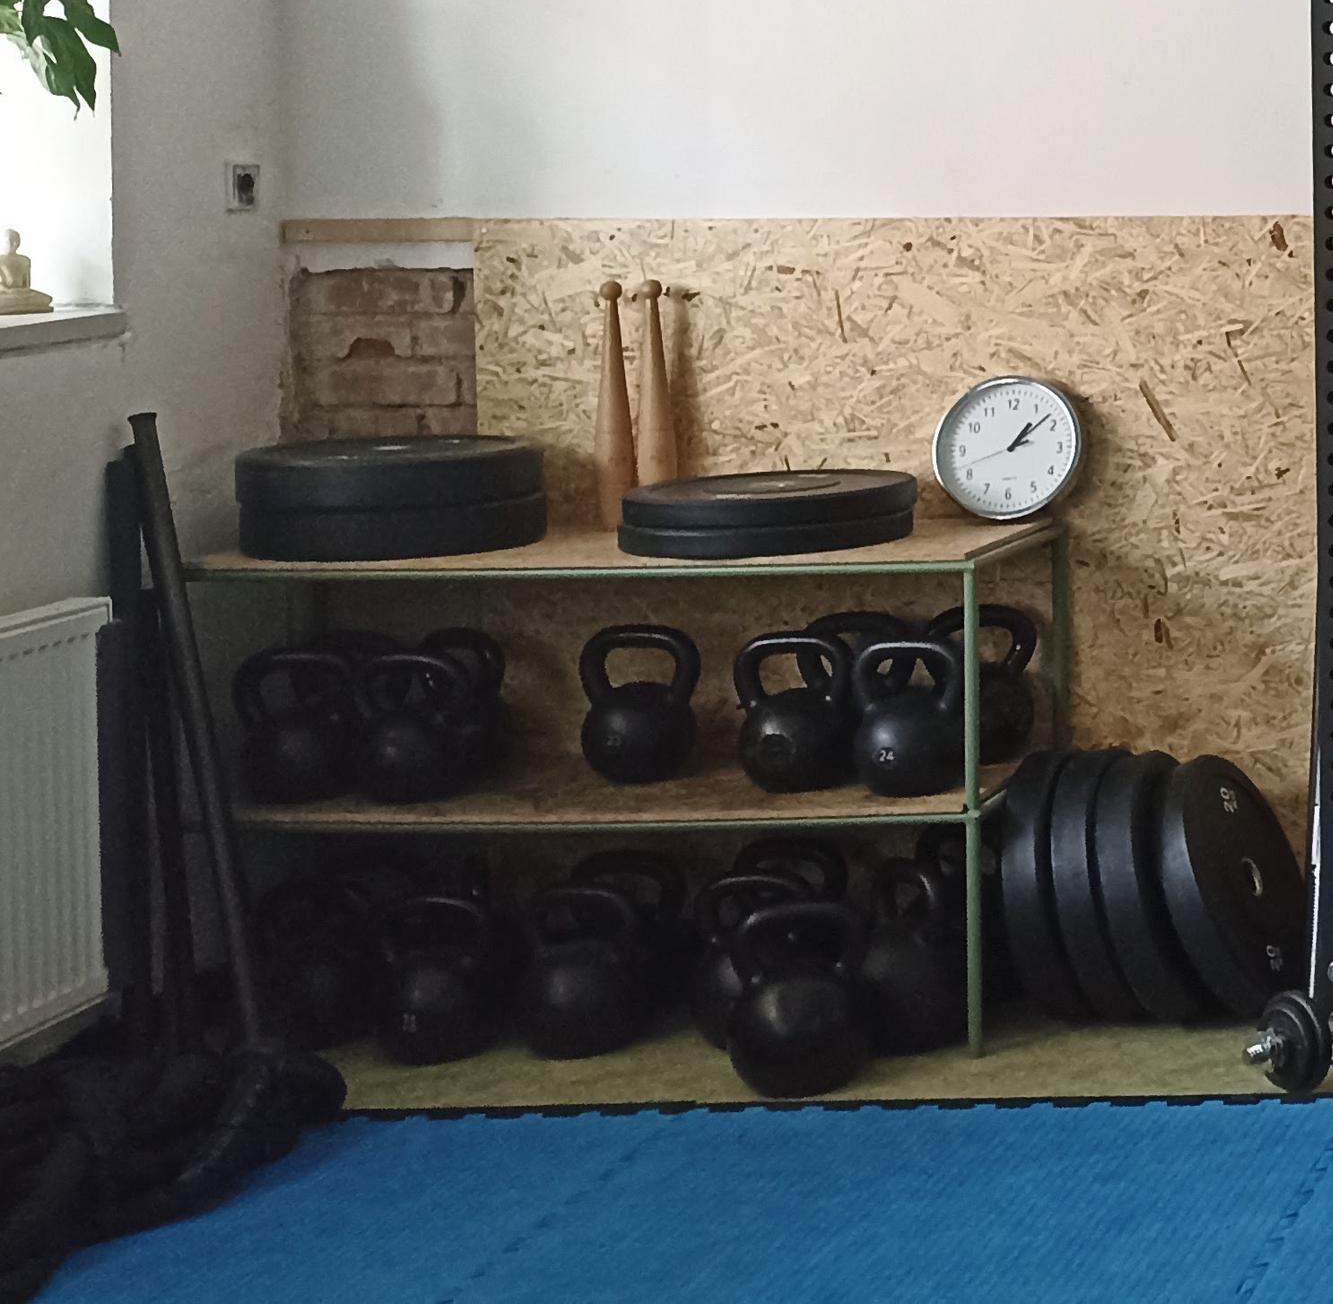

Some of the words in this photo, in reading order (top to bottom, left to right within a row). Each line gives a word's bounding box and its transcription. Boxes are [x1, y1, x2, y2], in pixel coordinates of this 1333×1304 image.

[1007, 398, 1020, 411] 12
[983, 407, 996, 418] 11
[968, 421, 981, 434] 10
[1049, 419, 1057, 432] 2
[958, 445, 966, 457] 9
[1056, 442, 1063, 454] 3
[966, 469, 973, 481] 8
[1047, 465, 1054, 476] 4
[983, 483, 991, 495] 7
[1030, 481, 1038, 494] 5
[1004, 488, 1012, 500] 6
[878, 749, 896, 763] 24
